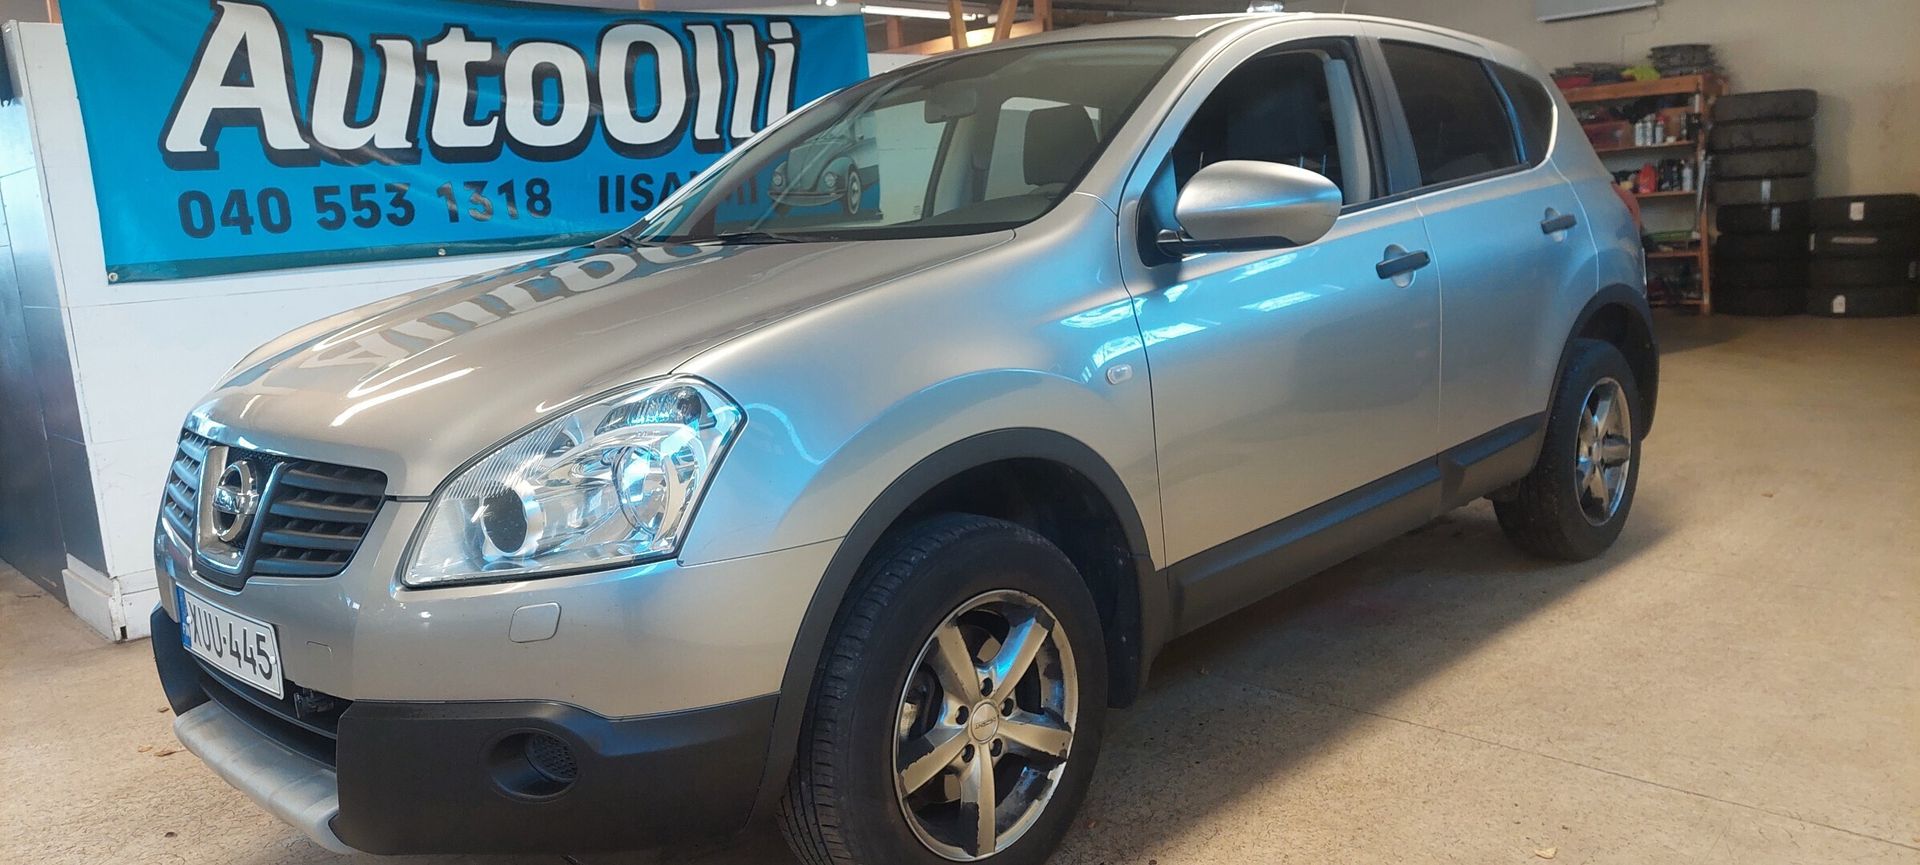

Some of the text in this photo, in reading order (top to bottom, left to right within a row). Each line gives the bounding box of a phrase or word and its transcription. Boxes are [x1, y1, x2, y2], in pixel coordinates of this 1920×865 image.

[160, 0, 799, 170] AutoOlli
[178, 187, 291, 238] 040
[312, 183, 415, 230] 553
[436, 178, 552, 222] 1318
